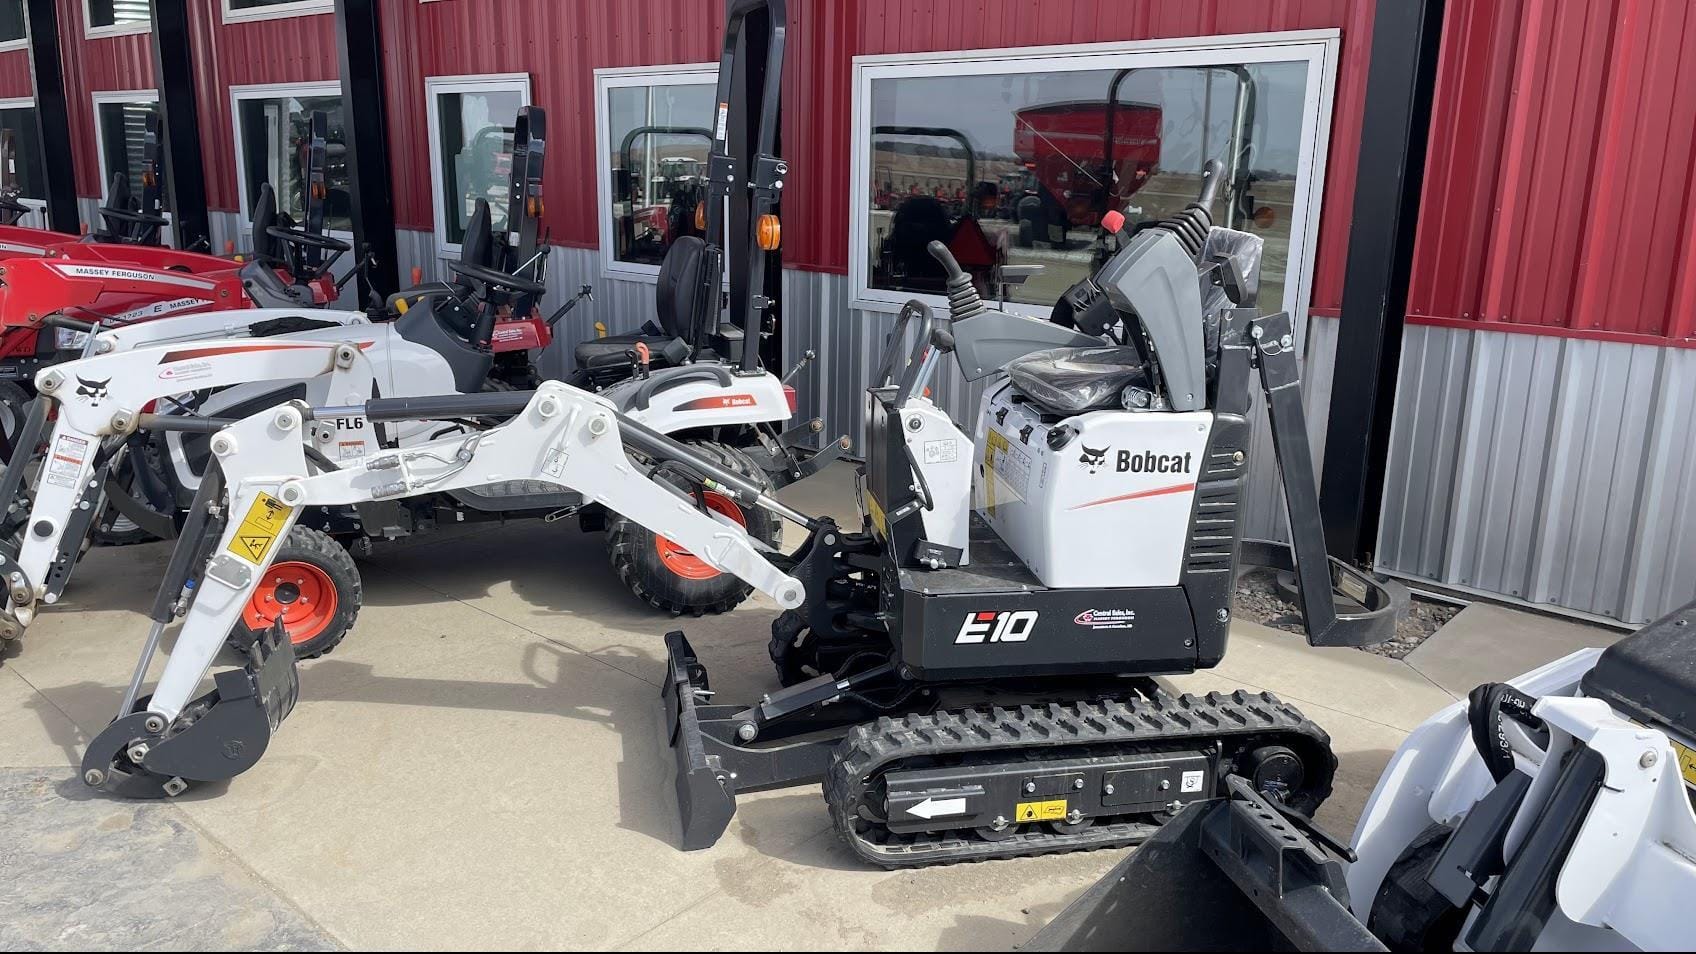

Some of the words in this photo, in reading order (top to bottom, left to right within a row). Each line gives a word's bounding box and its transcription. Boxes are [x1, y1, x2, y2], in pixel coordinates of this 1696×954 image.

[75, 267, 109, 276] MASSEY
[111, 270, 155, 280] FERGUSON
[153, 304, 163, 313] E
[169, 297, 199, 309] MASSEY
[336, 417, 364, 430] FL6
[1115, 449, 1192, 474] Bobcat
[953, 610, 1040, 645] E10
